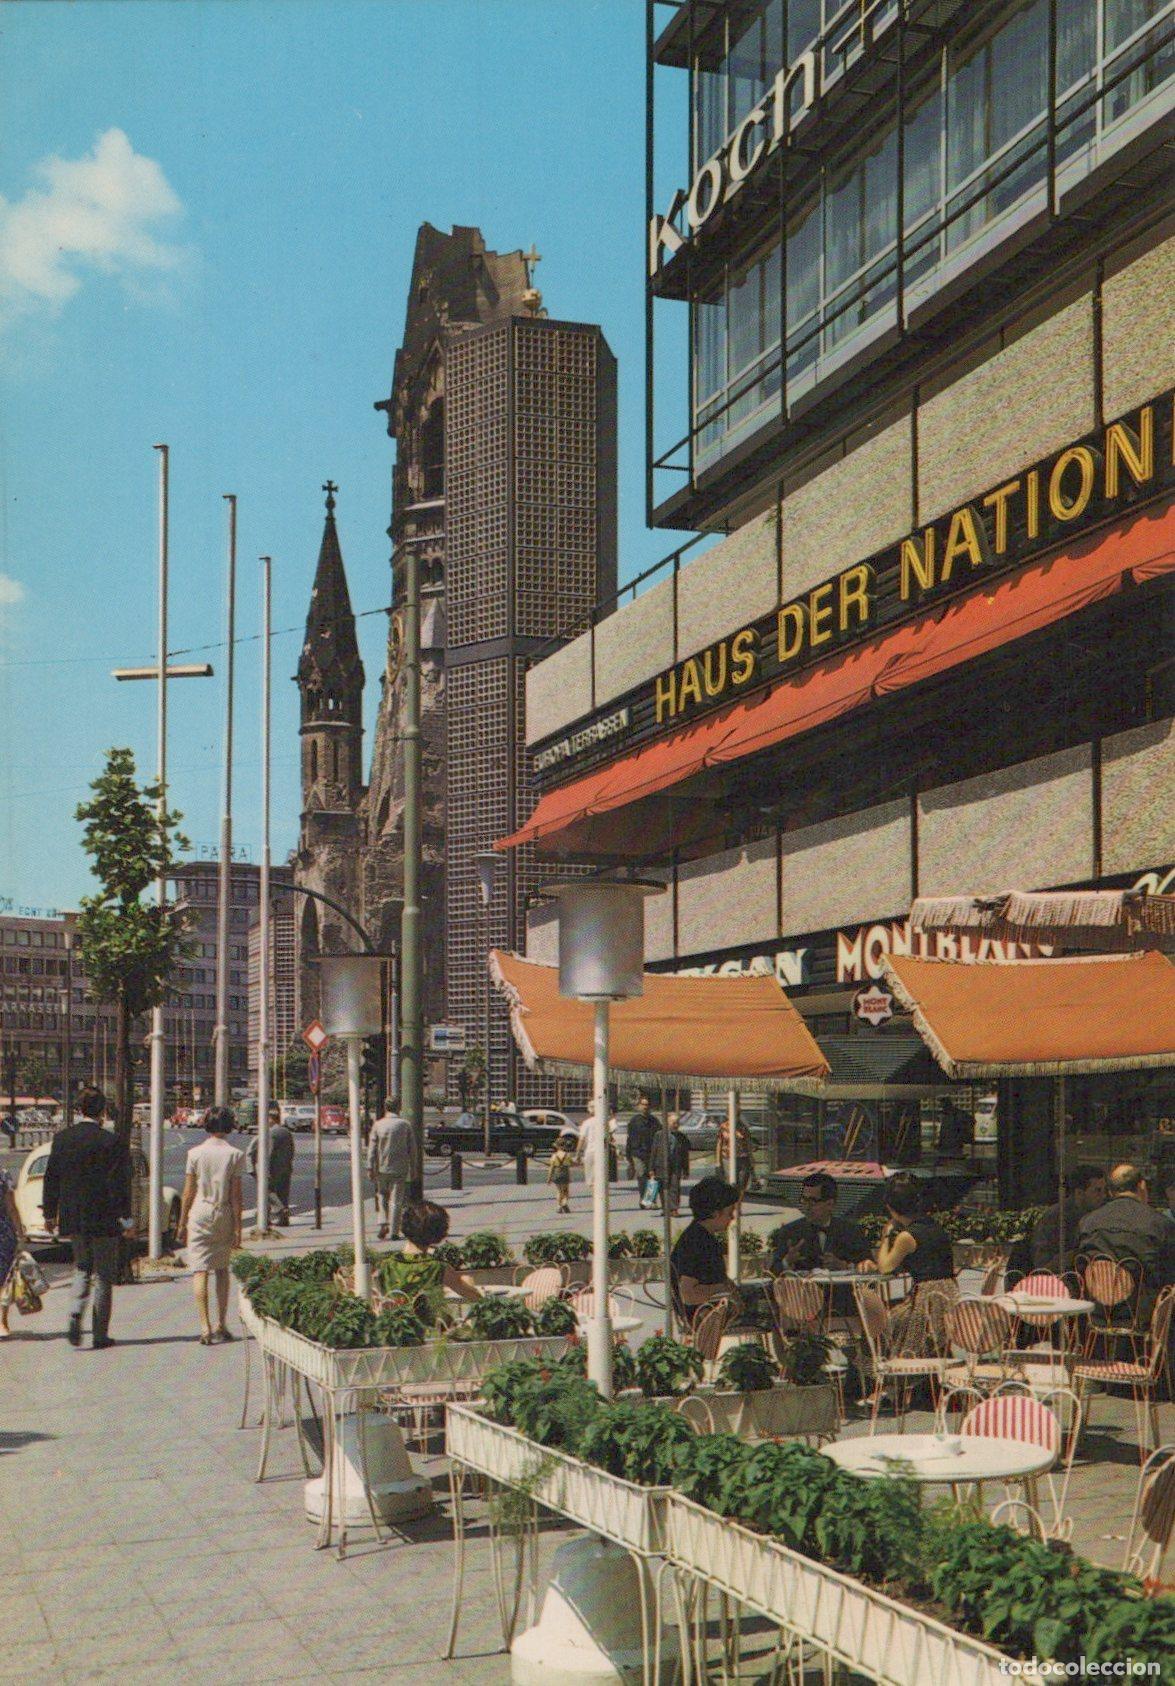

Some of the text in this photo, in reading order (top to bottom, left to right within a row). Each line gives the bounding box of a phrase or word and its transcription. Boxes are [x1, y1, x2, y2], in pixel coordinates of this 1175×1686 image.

[655, 393, 1175, 724] HAUS DER NATION
[836, 922, 1054, 983] MONTBL
